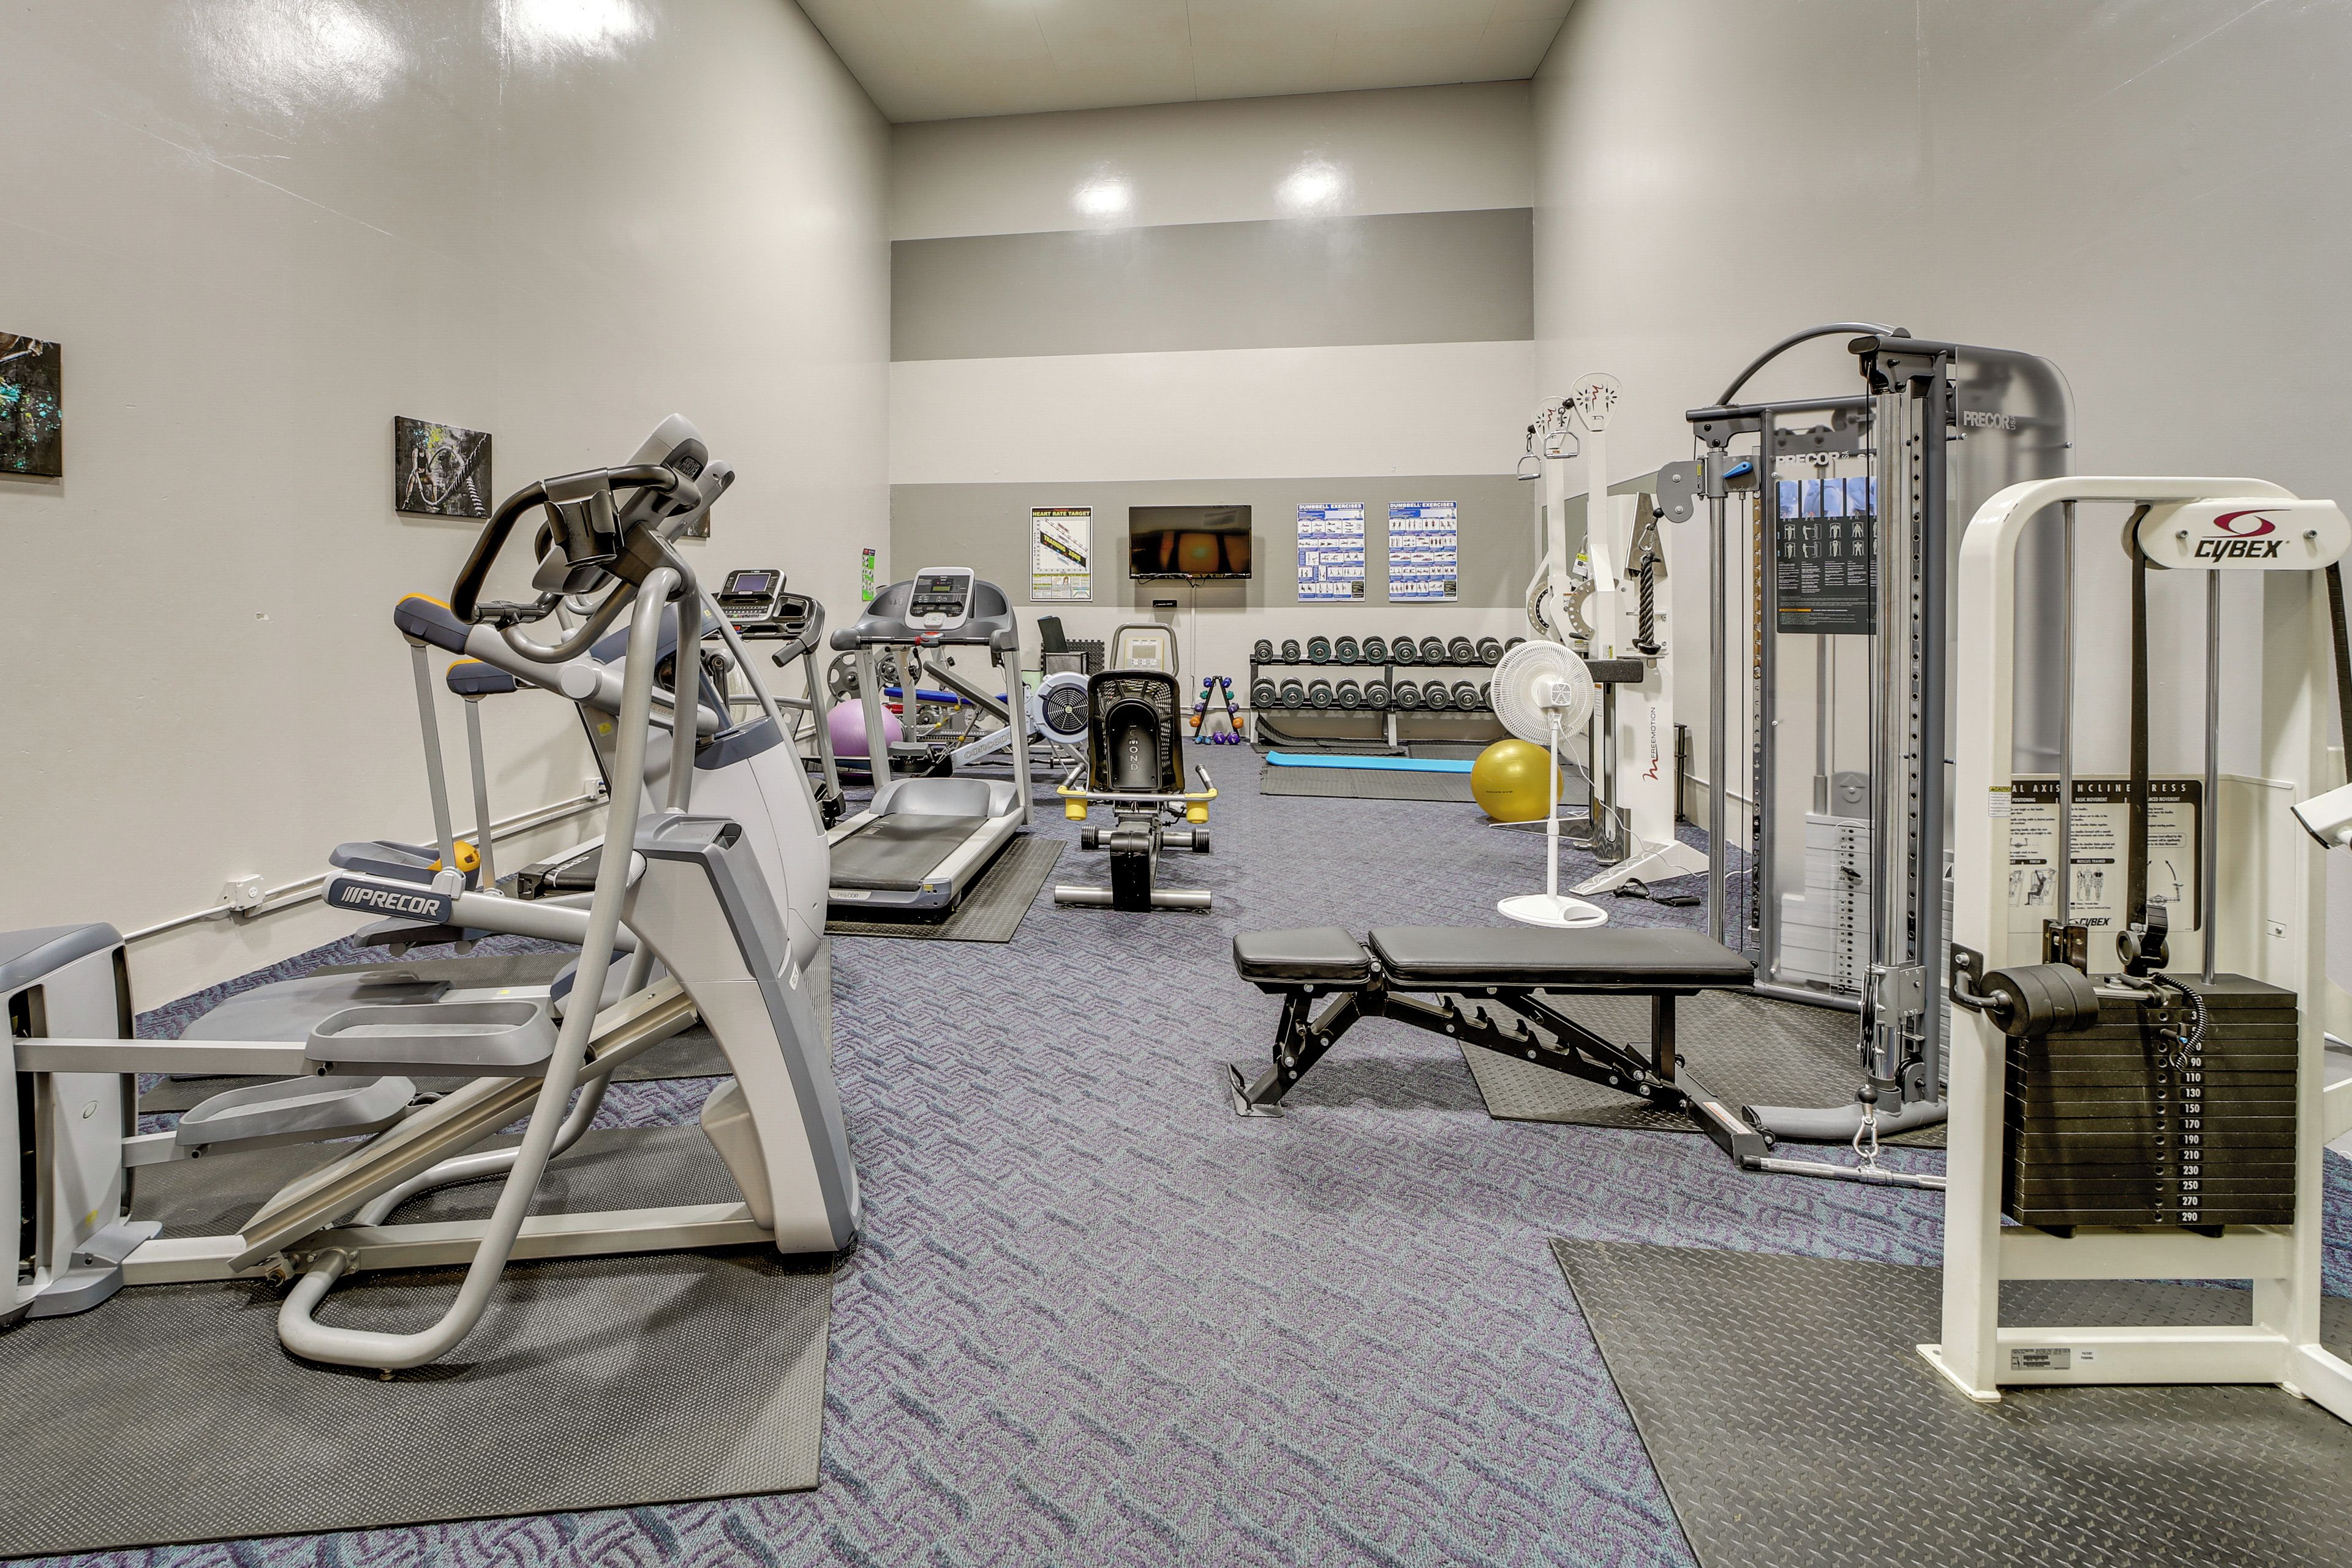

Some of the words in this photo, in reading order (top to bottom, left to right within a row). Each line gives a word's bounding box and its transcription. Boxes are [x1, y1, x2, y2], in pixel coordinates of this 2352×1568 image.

[1963, 410, 2010, 429] PRECOR
[1043, 534, 1066, 552] TRAINING
[1068, 549, 1082, 562] ZONE
[2194, 540, 2283, 563] CYBEX
[2012, 784, 2024, 793] AL
[2032, 784, 2060, 793] AXIS
[354, 889, 440, 917] PRECOR
[2079, 918, 2109, 927] CYBEX
[2186, 1073, 2201, 1082] 110
[2186, 1088, 2201, 1097] 130
[2185, 1104, 2199, 1112] 150
[2185, 1120, 2199, 1128] 170
[2184, 1135, 2199, 1144] 190
[2184, 1150, 2199, 1159] 210
[2183, 1166, 2198, 1174] 230
[2183, 1181, 2198, 1189] 250
[2182, 1197, 2197, 1205] 270
[2182, 1212, 2197, 1221] 290
